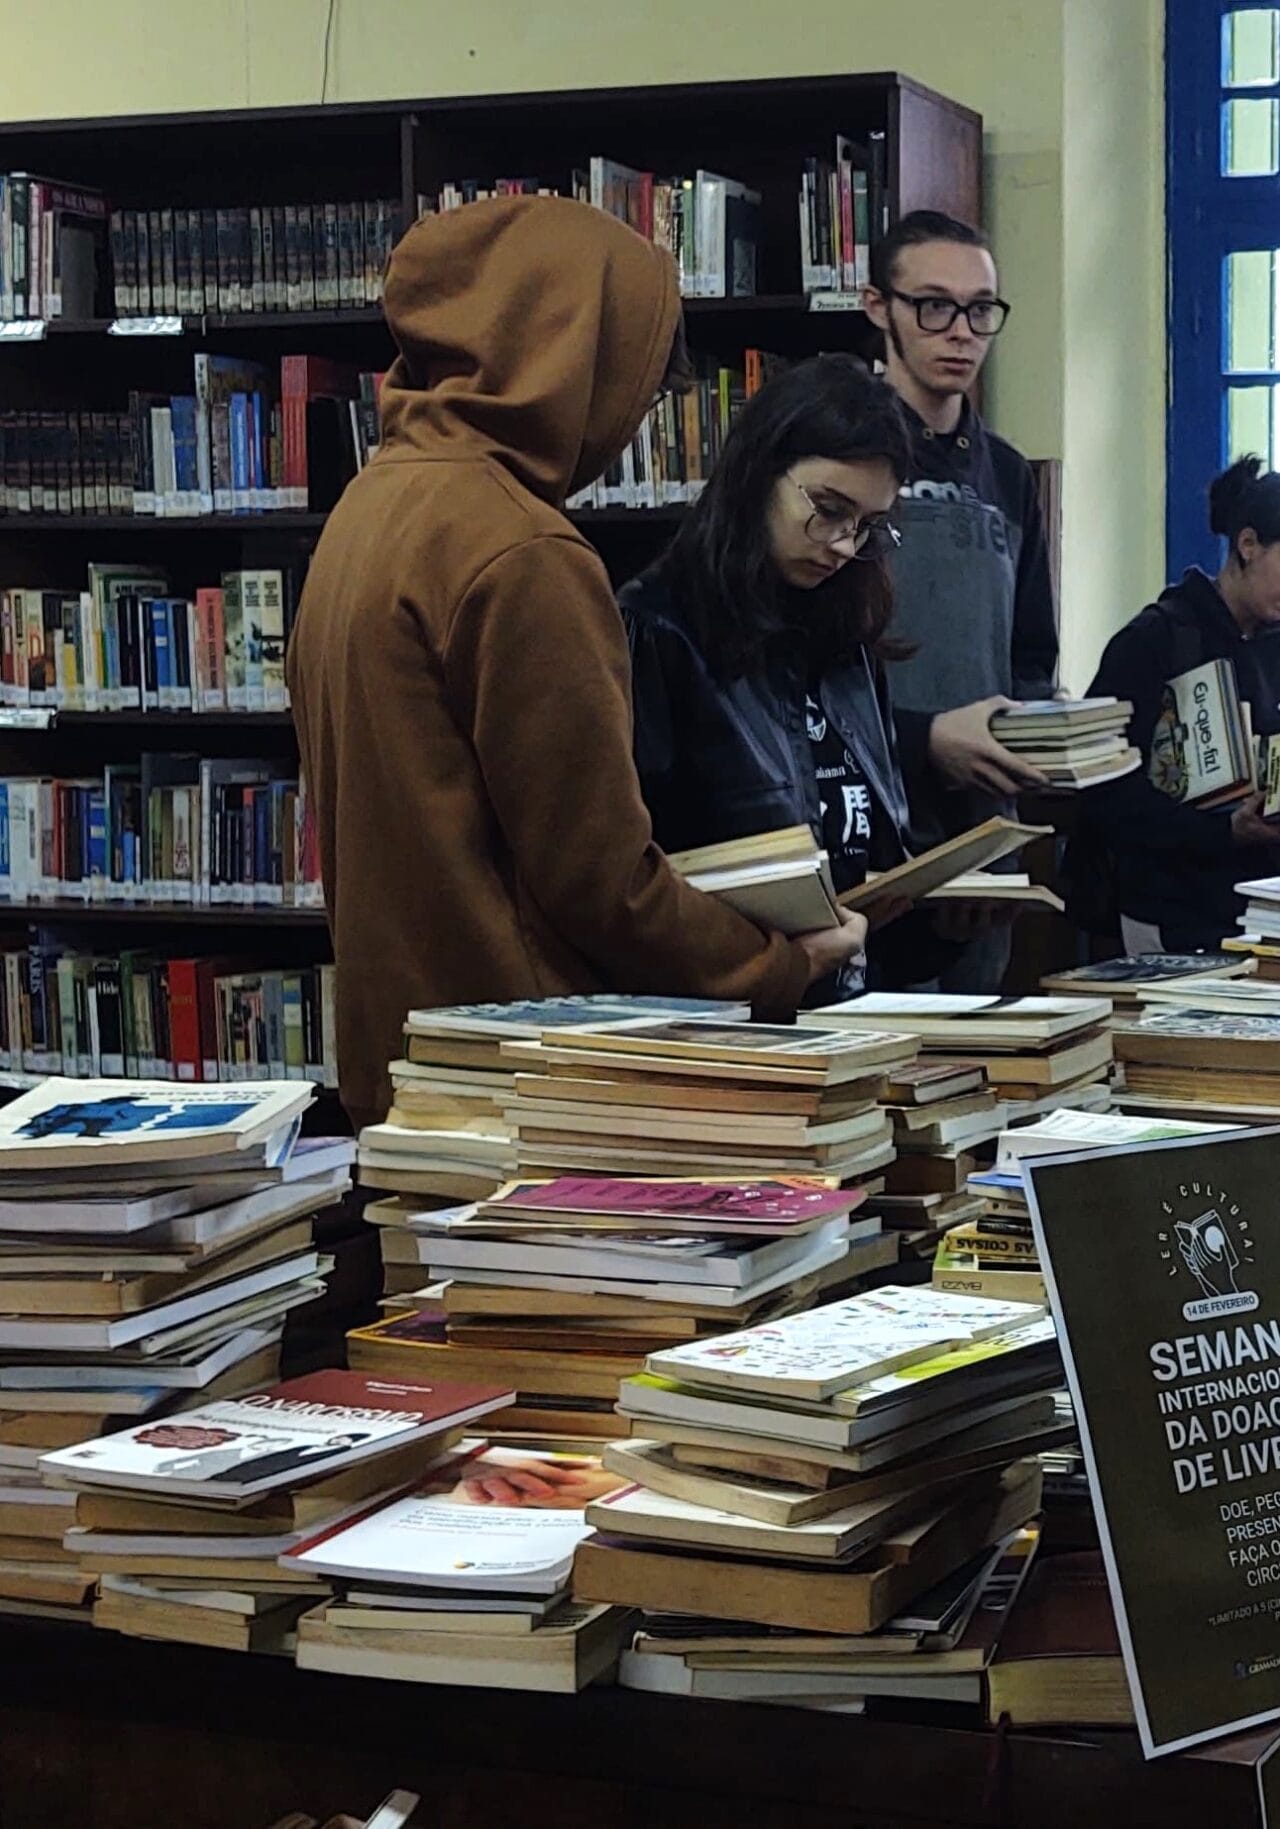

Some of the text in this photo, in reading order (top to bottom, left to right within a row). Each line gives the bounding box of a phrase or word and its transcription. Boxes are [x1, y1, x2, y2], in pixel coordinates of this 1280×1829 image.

[957, 1238, 1009, 1251] COISAS
[1158, 1232, 1178, 1276] LER
[942, 1280, 982, 1291] BAZZI
[1186, 1295, 1255, 1317] 14 DE FEVEREIRO
[1165, 1415, 1208, 1450] DA
[1173, 1452, 1218, 1493] DE
[1220, 1500, 1254, 1522] DOE,
[1229, 1542, 1269, 1568] FAÇA
